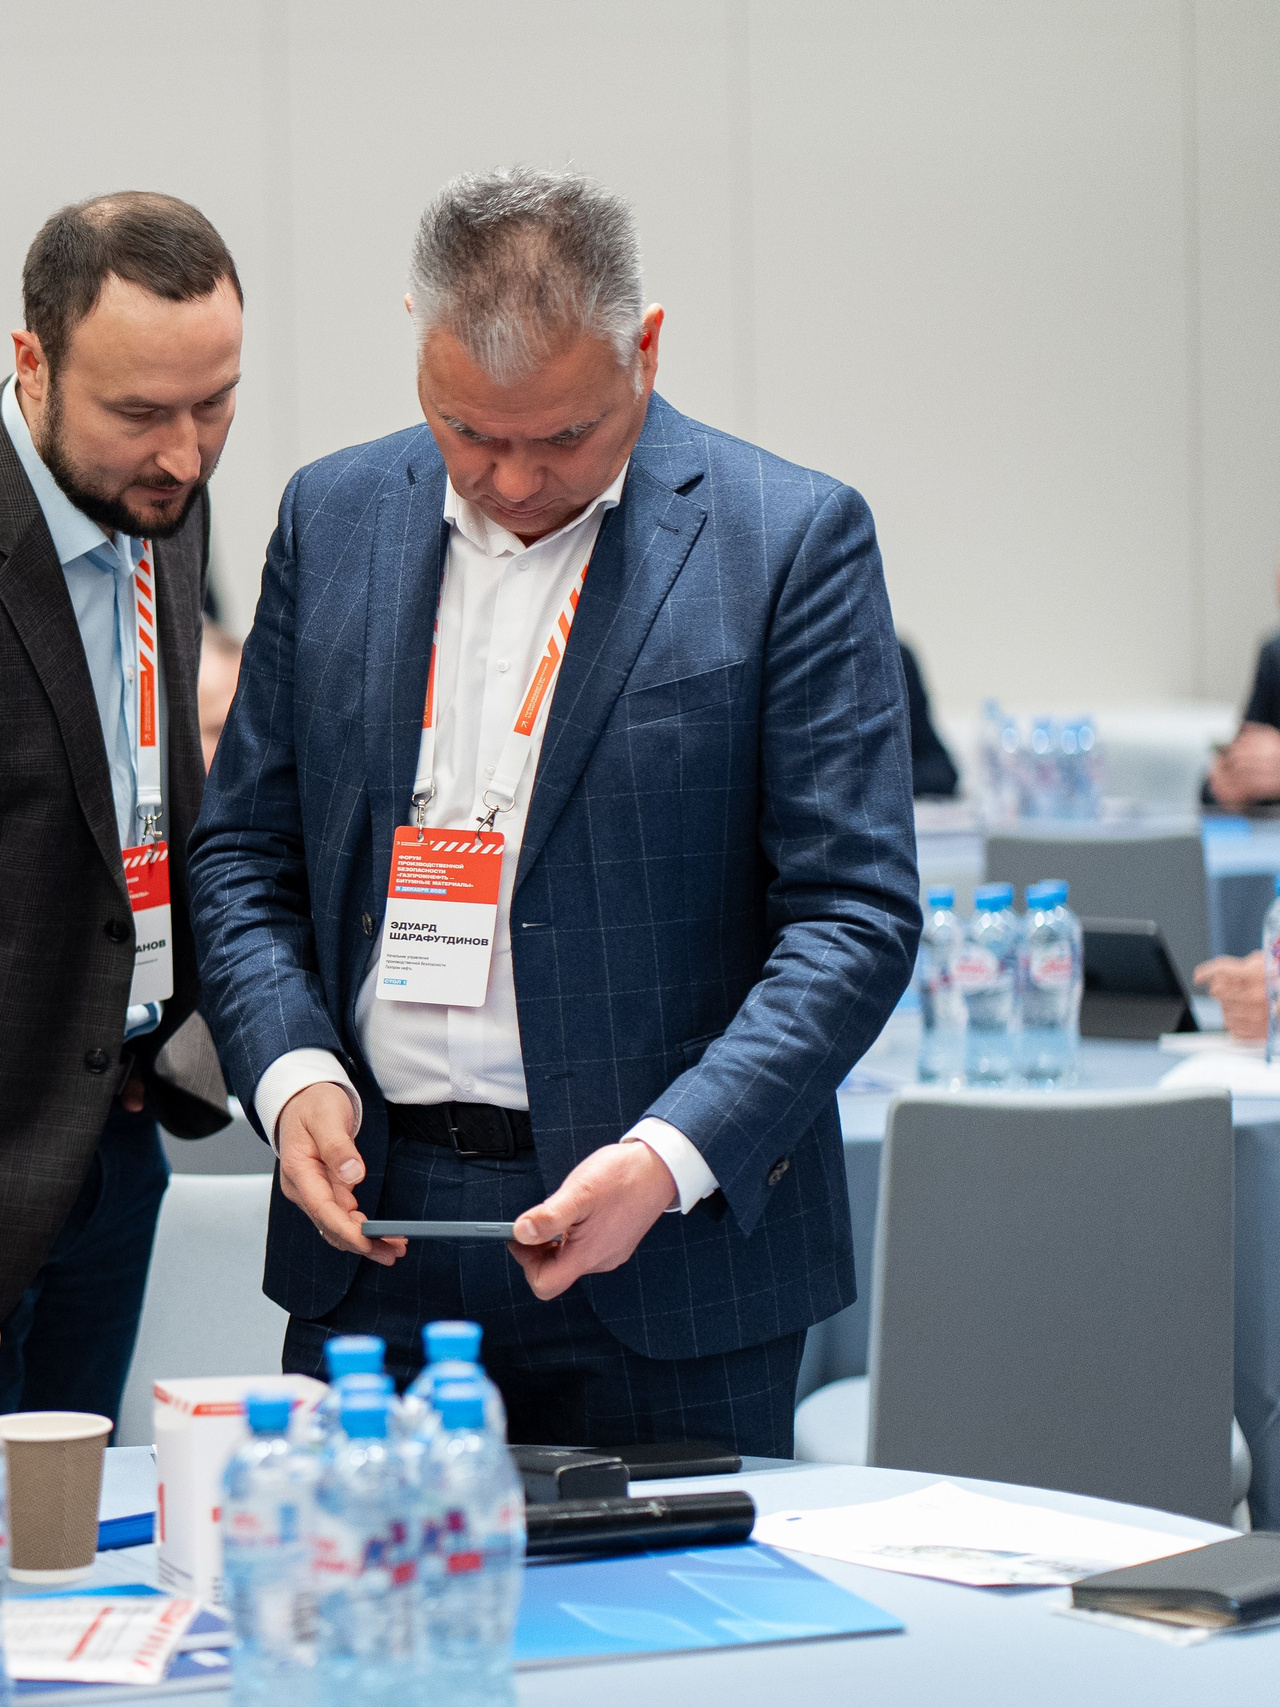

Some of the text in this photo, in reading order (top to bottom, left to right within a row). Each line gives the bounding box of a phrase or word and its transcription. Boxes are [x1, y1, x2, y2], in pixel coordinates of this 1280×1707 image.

[397, 860, 465, 869] ПРОИЗВОДСТВЕННОЙ
[397, 866, 447, 874] БЕЗОПАСНОСТИ
[390, 921, 437, 933] ЭДУАРД
[389, 932, 489, 946] ШАРАФУТДИНОВ
